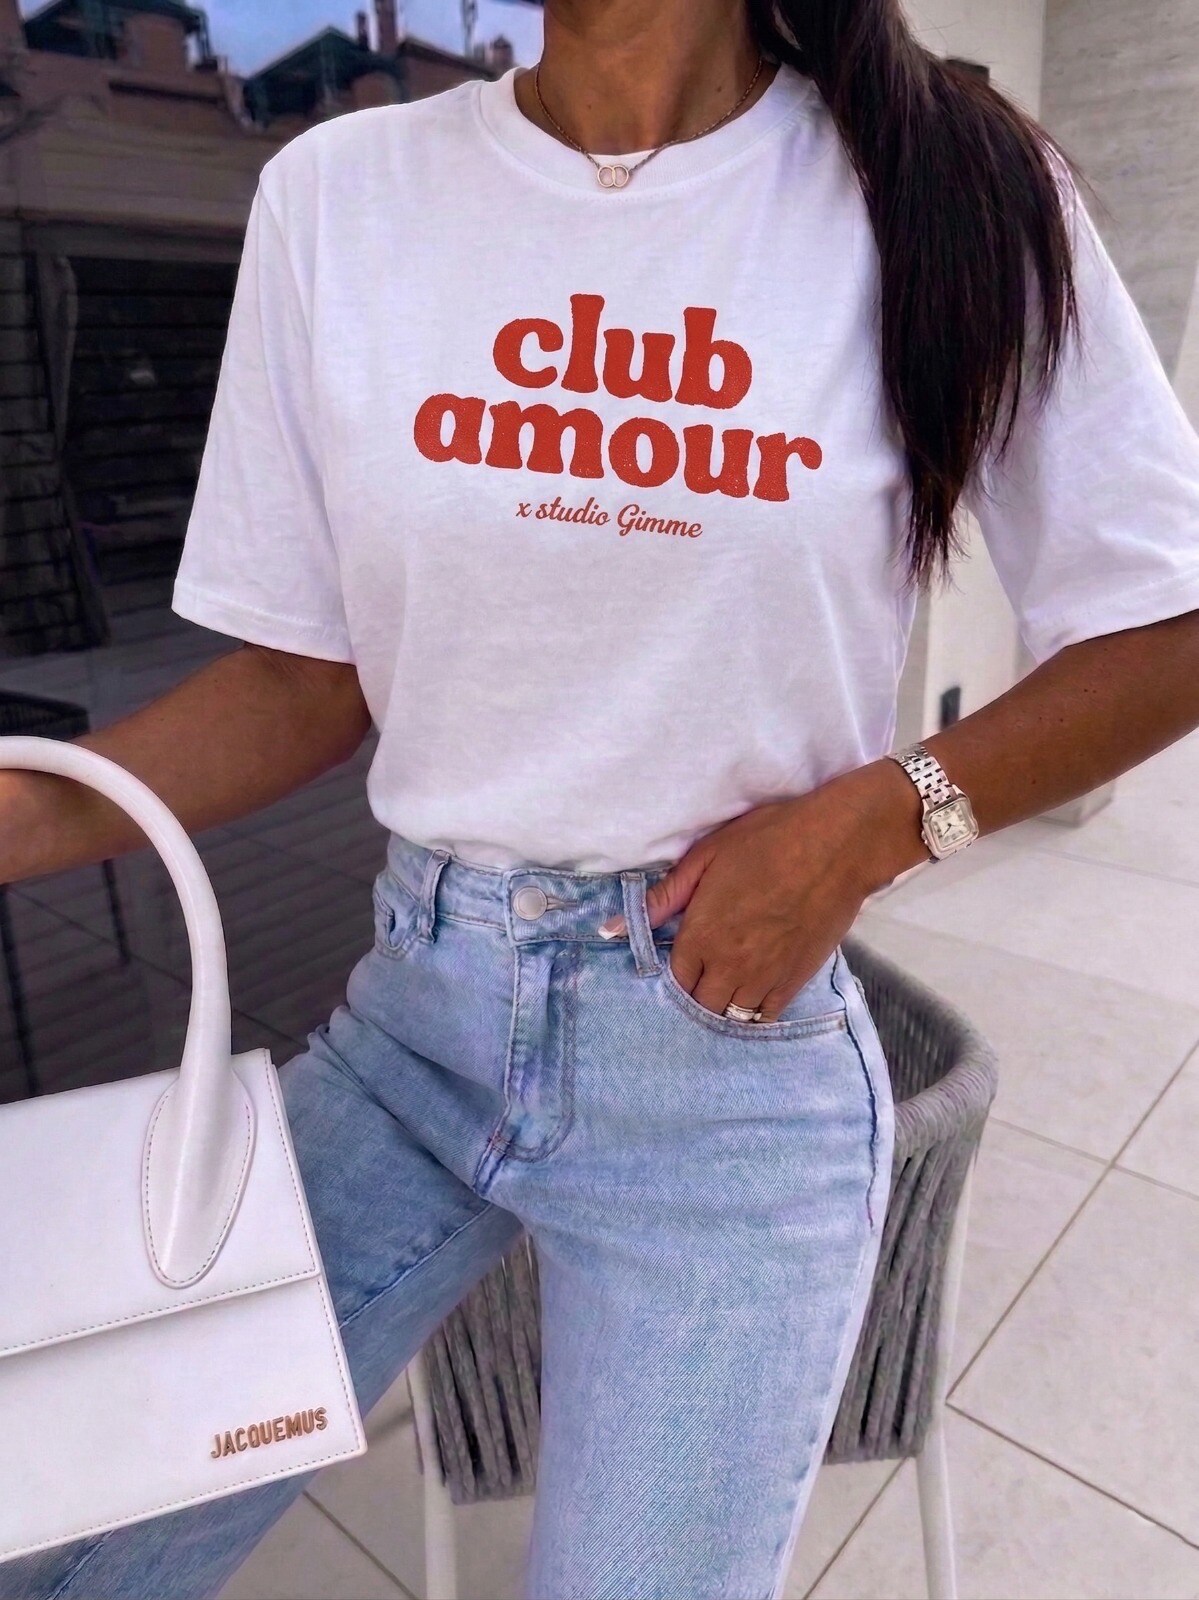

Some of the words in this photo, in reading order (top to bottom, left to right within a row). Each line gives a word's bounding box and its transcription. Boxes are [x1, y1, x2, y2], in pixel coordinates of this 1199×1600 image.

[492, 293, 752, 409] club
[413, 393, 823, 502] amour
[516, 502, 532, 518] x
[535, 496, 610, 526] studio
[617, 503, 703, 538] Gimme
[210, 1407, 328, 1458] JACQUEMUS
